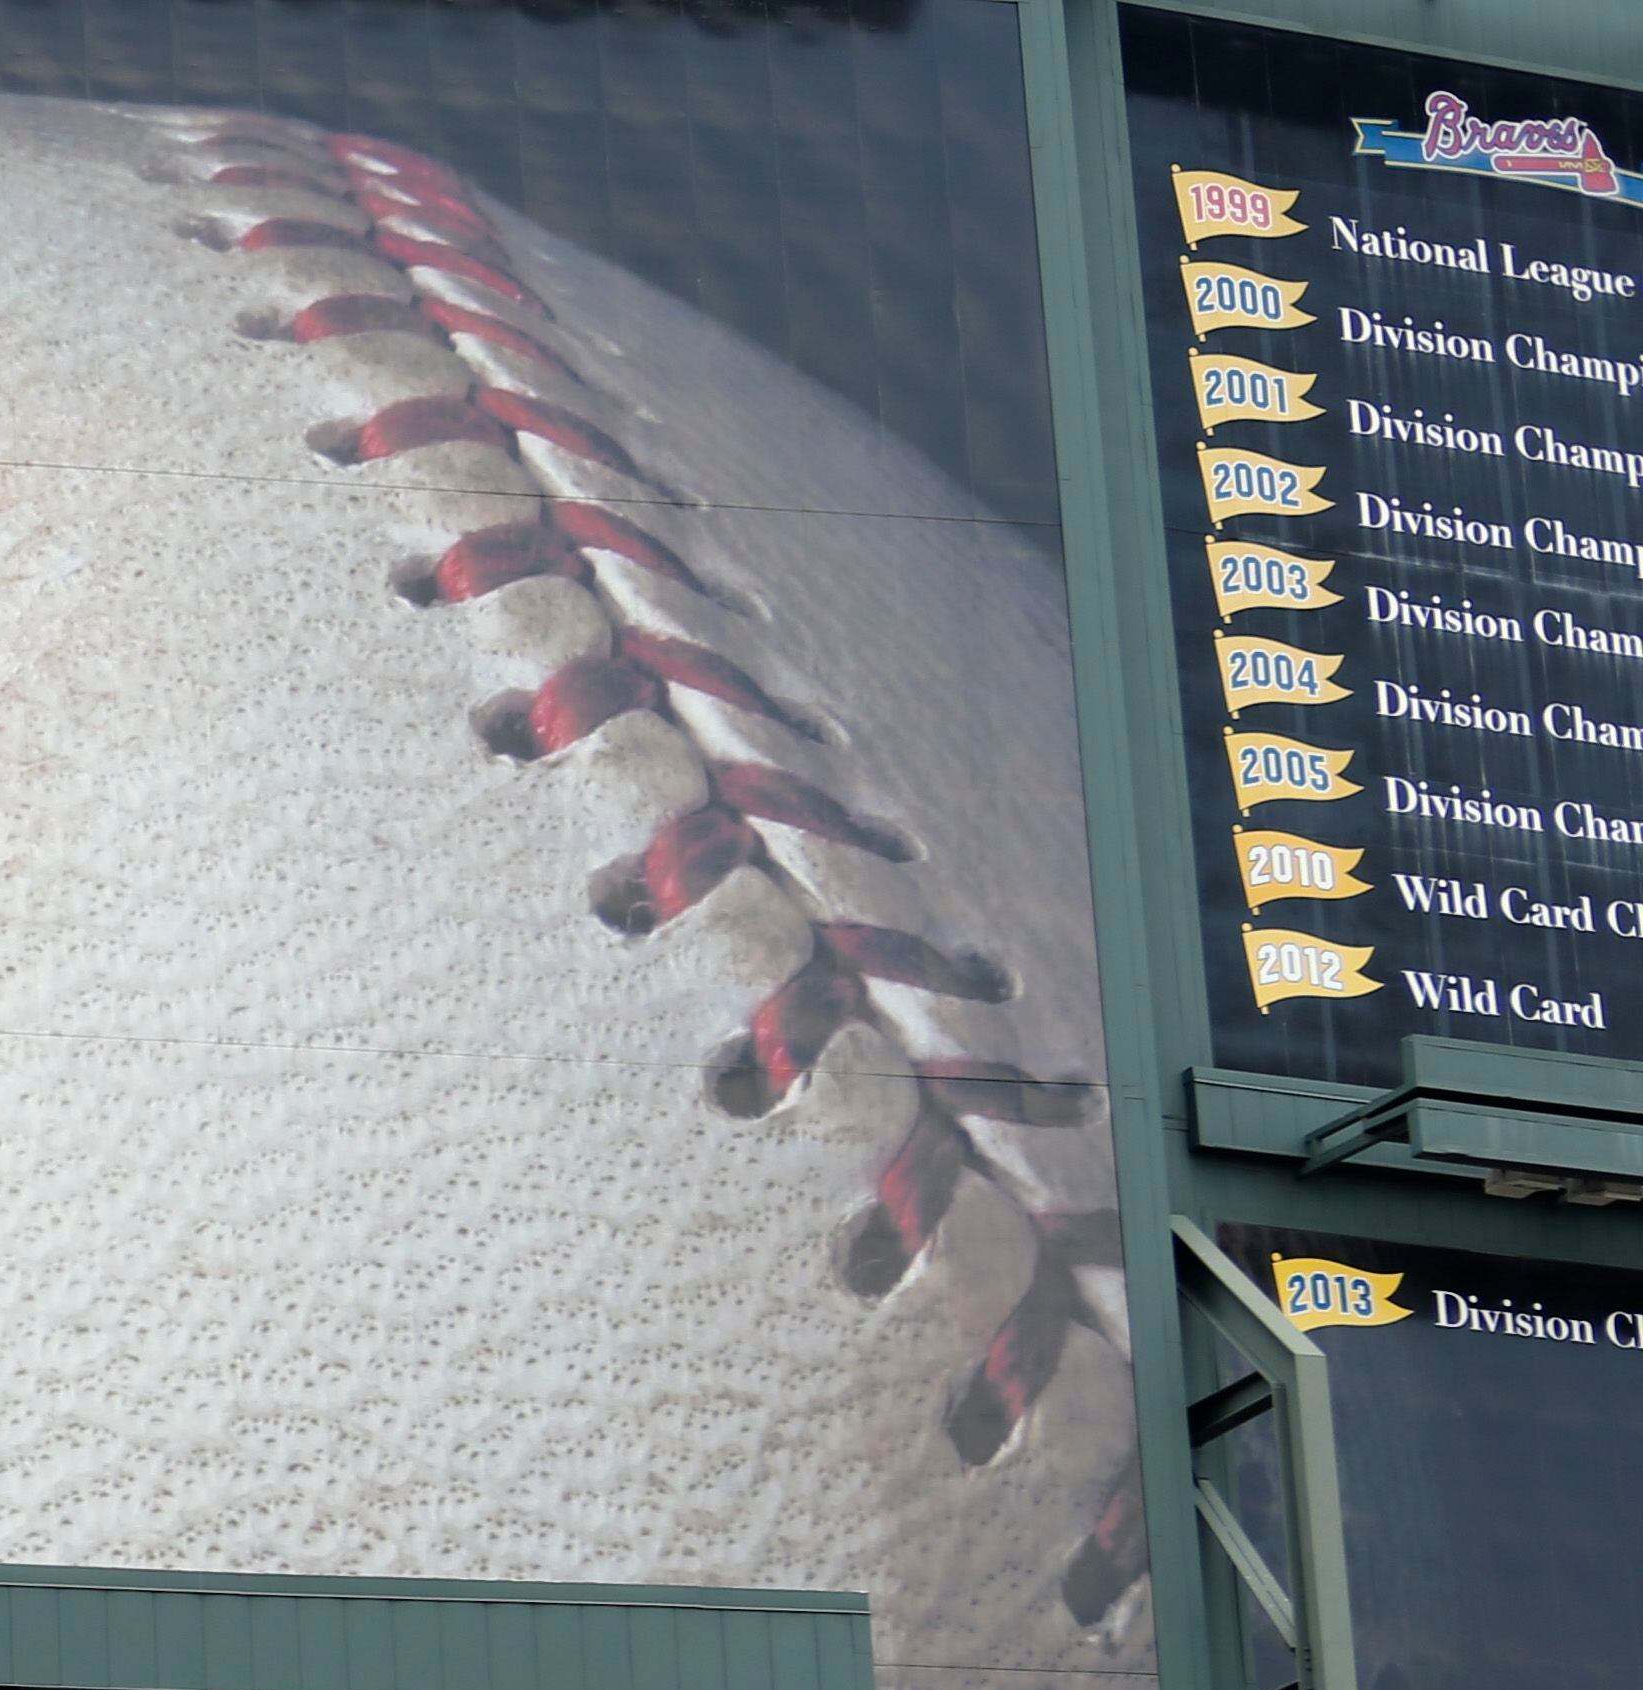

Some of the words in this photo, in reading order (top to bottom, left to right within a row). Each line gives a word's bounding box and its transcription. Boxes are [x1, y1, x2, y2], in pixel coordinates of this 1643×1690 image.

[1422, 91, 1583, 161] Braves
[1189, 183, 1272, 229] 1999
[1329, 215, 1491, 274] National
[1499, 242, 1636, 303] League
[1195, 275, 1282, 321] 2000
[1338, 306, 1496, 363] Division
[1204, 368, 1288, 413] 2001
[1346, 398, 1506, 457] Division
[1213, 462, 1299, 510] 2002
[1355, 491, 1514, 550] Division
[1221, 552, 1309, 601] 2003
[1364, 585, 1524, 643] Division
[1532, 608, 1643, 659] Cham
[1229, 648, 1320, 697] 2004
[1373, 679, 1533, 737] Division
[1240, 744, 1329, 792] 2005
[1382, 775, 1545, 833] Division
[1248, 844, 1335, 892] 2010
[1391, 872, 1489, 920] Wild
[1499, 886, 1597, 933] Card
[1256, 940, 1344, 991] 2012
[1400, 969, 1501, 1017] Wild
[1509, 983, 1607, 1030] Card
[1287, 1271, 1373, 1318] 2013
[1431, 1289, 1596, 1345] Division
